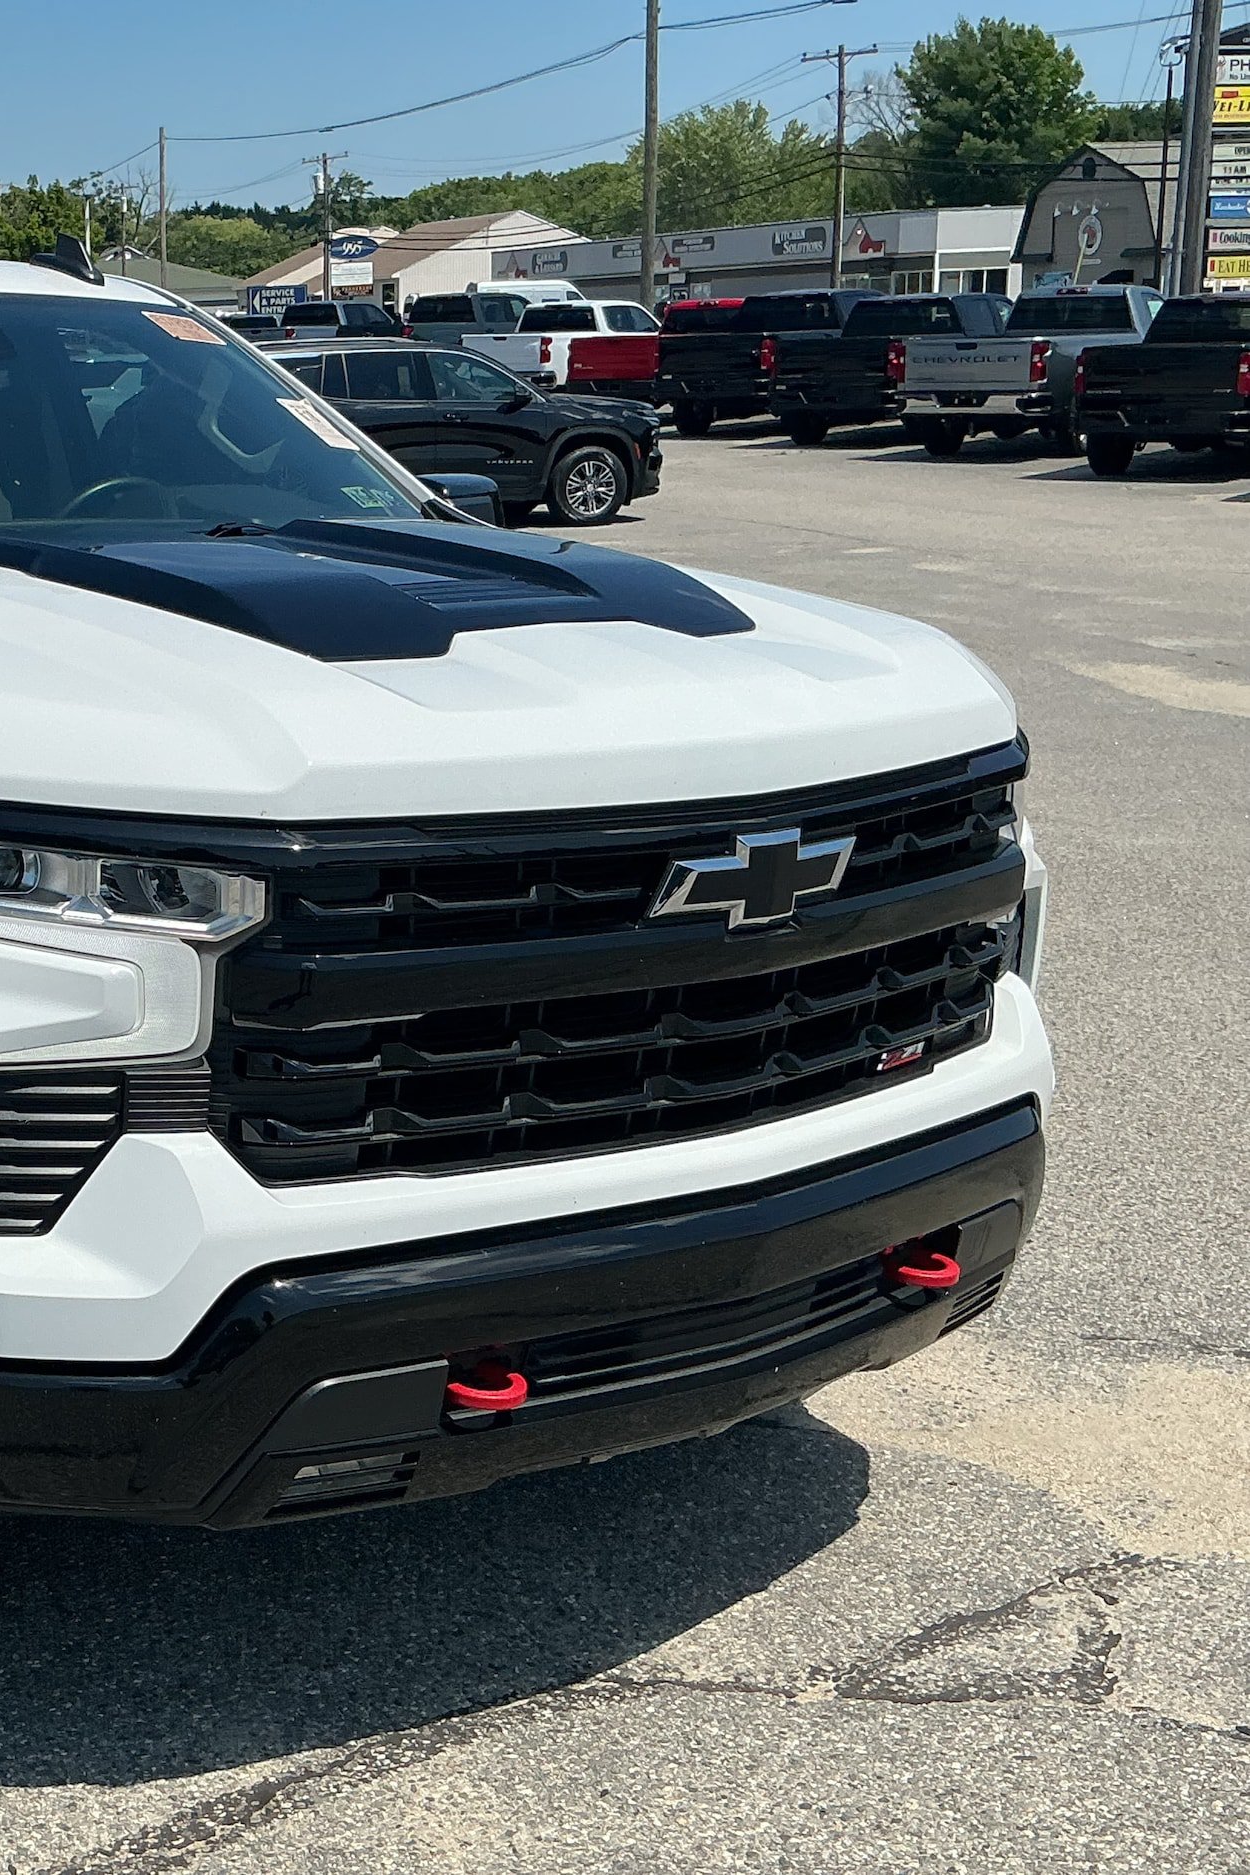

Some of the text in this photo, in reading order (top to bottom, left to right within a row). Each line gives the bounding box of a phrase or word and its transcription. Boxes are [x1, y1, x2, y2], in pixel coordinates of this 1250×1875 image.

[261, 288, 295, 298] SERVICE
[261, 296, 296, 306] & PARTS
[912, 355, 1019, 364] CHEVROLET
